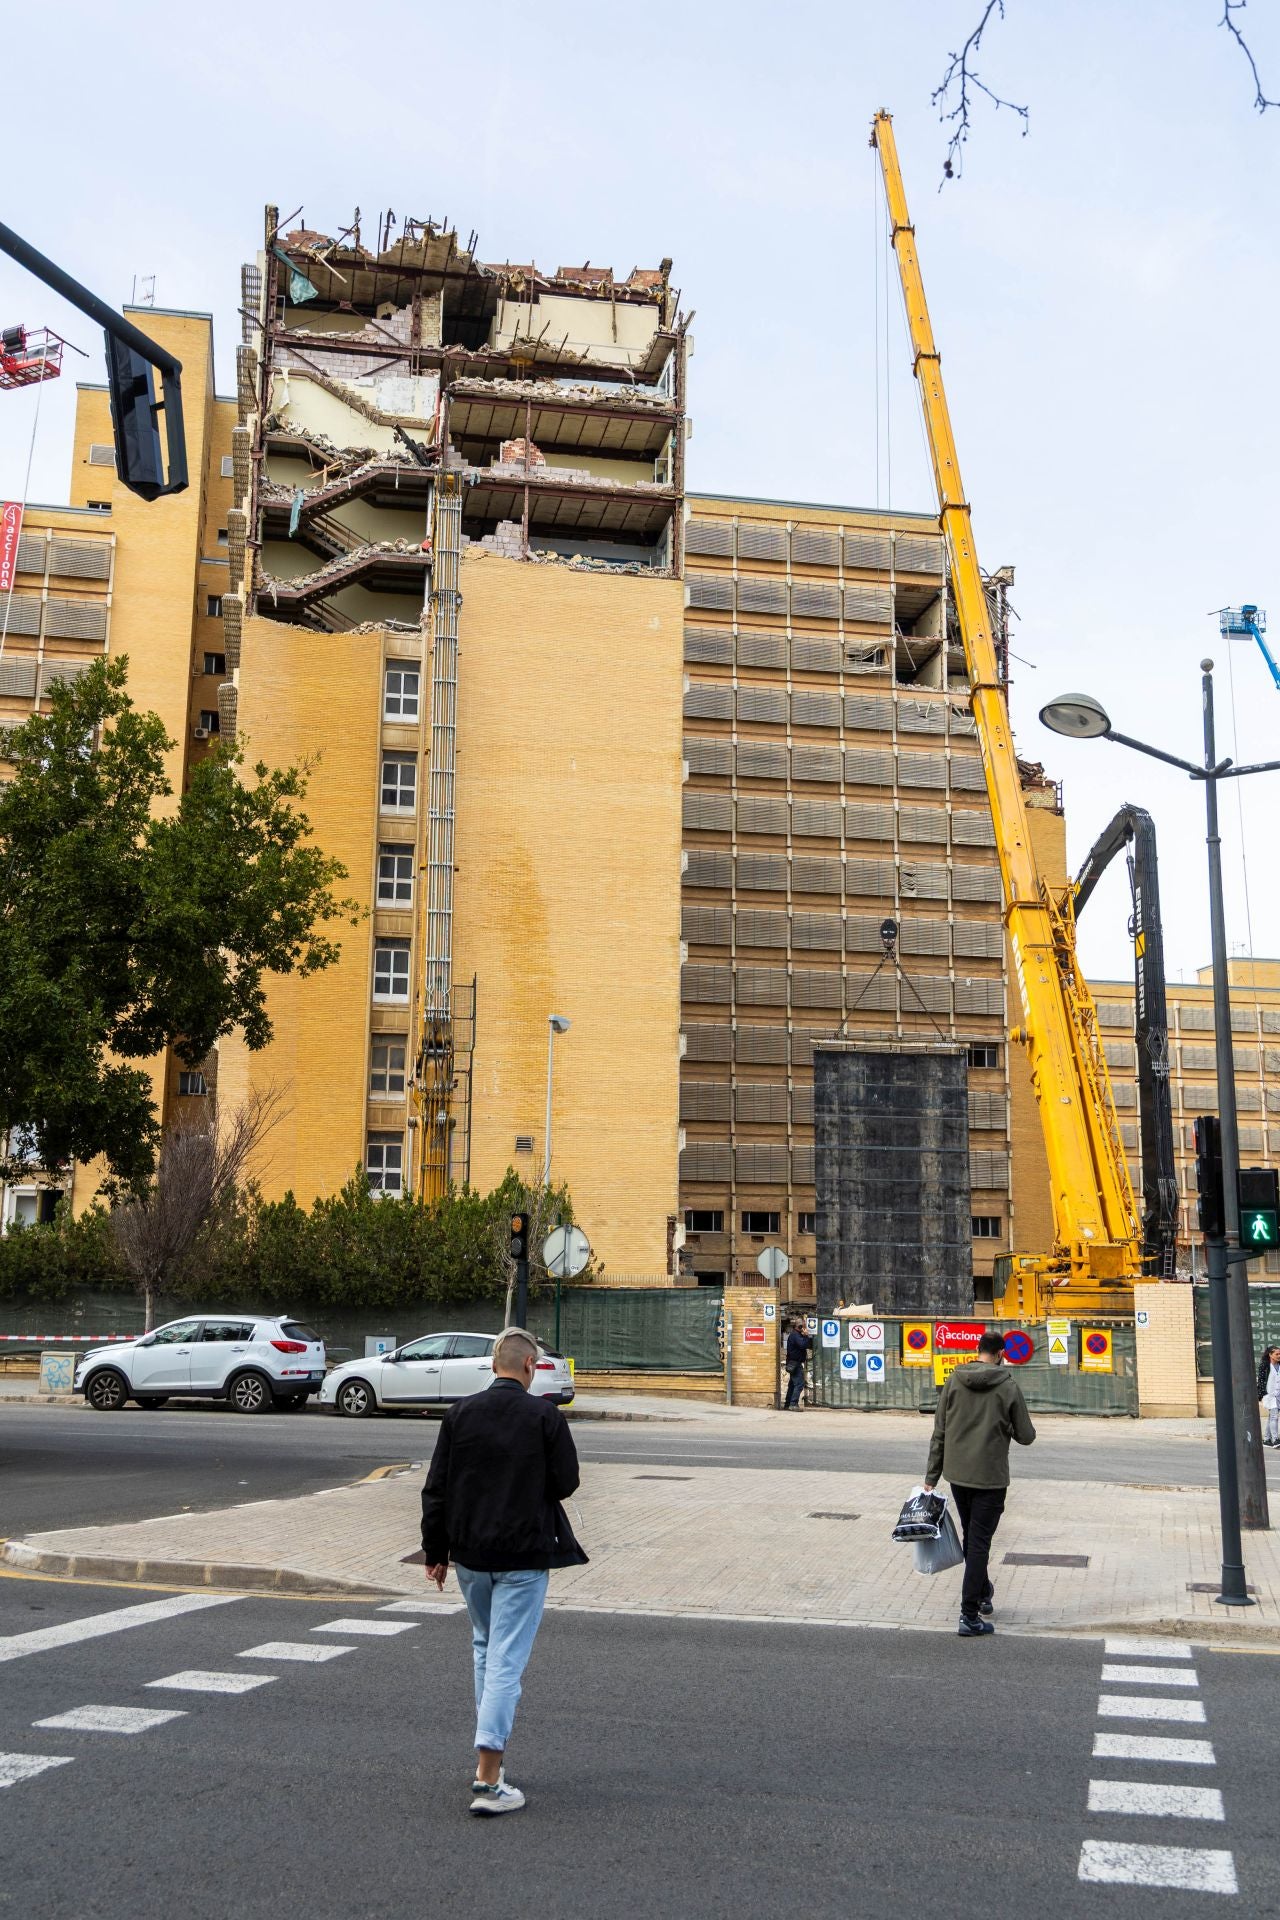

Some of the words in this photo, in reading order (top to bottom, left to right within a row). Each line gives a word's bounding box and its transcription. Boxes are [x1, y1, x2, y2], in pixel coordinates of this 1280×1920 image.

[1, 526, 14, 588] acciona
[1138, 957, 1146, 1020] BERRI
[945, 1330, 983, 1341] acciona
